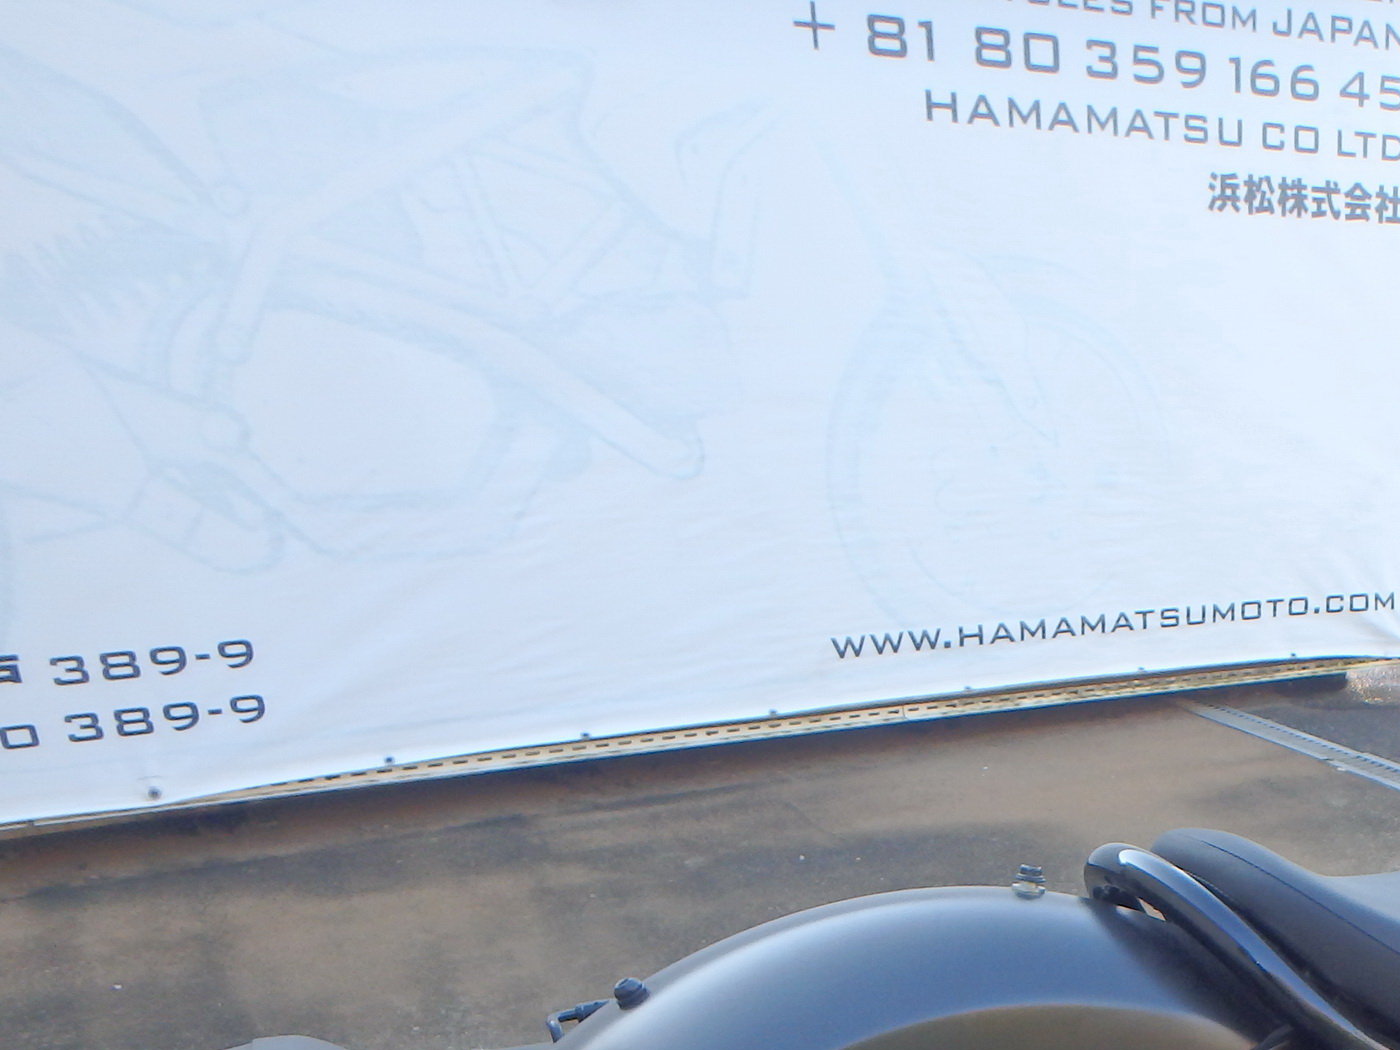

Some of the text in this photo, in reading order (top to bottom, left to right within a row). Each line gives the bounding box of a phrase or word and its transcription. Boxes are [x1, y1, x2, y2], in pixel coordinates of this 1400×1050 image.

[1150, 0, 1257, 33] FROM
[866, 14, 936, 62] 81
[974, 25, 1061, 75] 80
[1085, 38, 1207, 89] 359
[1228, 57, 1320, 102] 166
[924, 88, 1243, 148] HAMAMATSU
[1261, 121, 1320, 155] CO
[830, 591, 1395, 660] WWW.HAMAMATSUMOTO.COM
[49, 638, 255, 687] 389-9
[63, 694, 266, 743] 389-9
